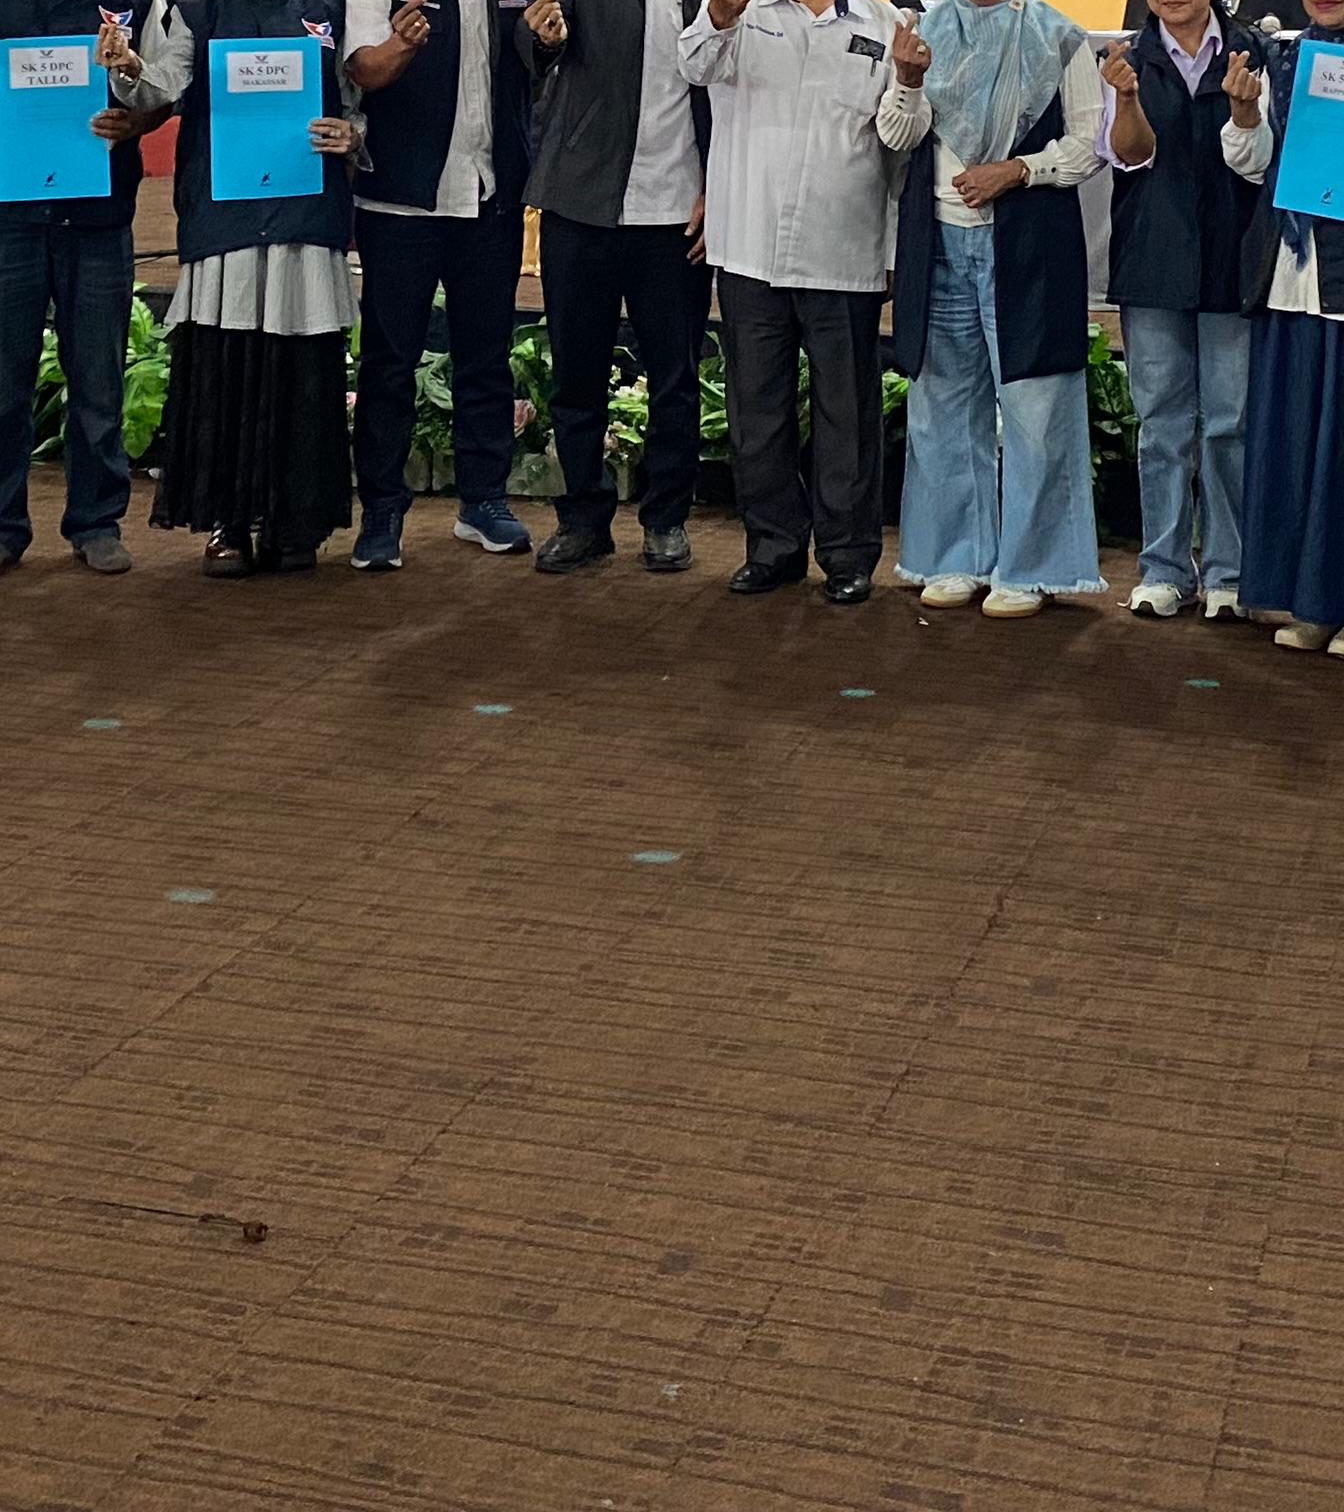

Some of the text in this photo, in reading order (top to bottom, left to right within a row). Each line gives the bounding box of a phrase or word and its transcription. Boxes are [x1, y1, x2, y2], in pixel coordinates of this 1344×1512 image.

[21, 61, 75, 73] SK 5 DPC
[239, 65, 290, 76] SK 5 DPC
[26, 74, 70, 86] TALLO
[1320, 71, 1337, 83] SK
[1337, 73, 1344, 84] 5
